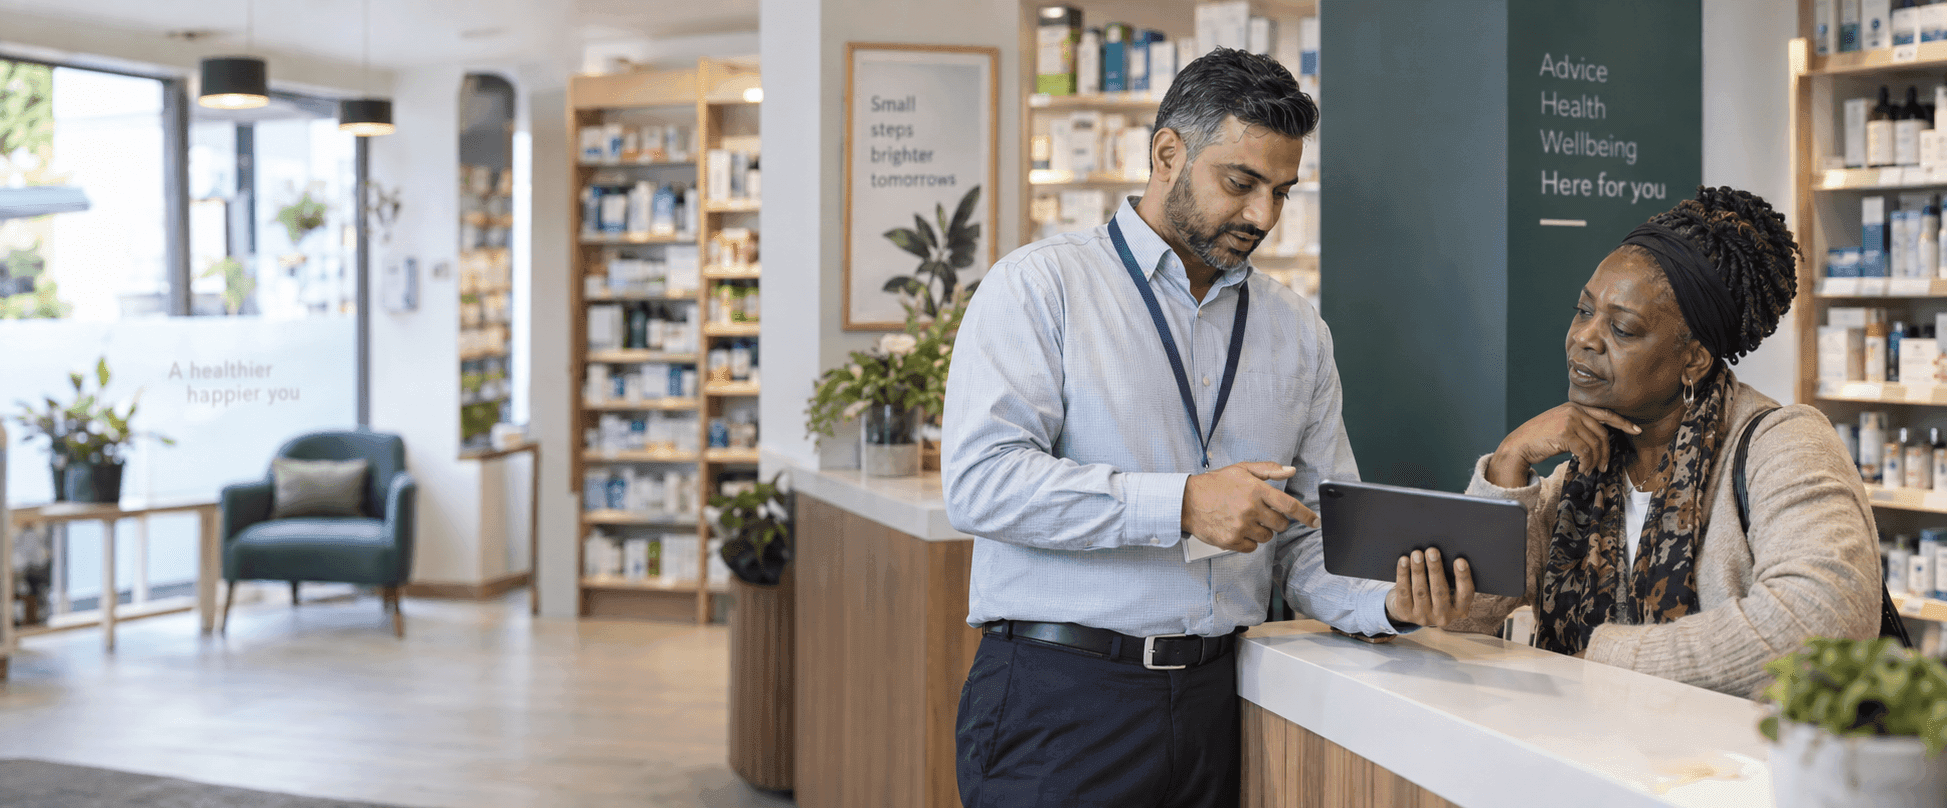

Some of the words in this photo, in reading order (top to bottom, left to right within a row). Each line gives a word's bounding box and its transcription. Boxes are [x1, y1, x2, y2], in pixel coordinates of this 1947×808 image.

[1539, 53, 1608, 83] Advice
[871, 95, 916, 112] Small
[1541, 91, 1606, 119] Health
[871, 122, 914, 140] steps
[871, 145, 934, 167] brighter
[1540, 129, 1637, 165] Wellbeing
[871, 173, 956, 188] tomorrows
[1541, 170, 1592, 197] Here
[1597, 171, 1627, 197] for
[1630, 181, 1666, 204] you
[168, 361, 183, 379] A
[189, 359, 273, 379] healthier
[187, 384, 260, 408] happier
[267, 387, 300, 406] you
